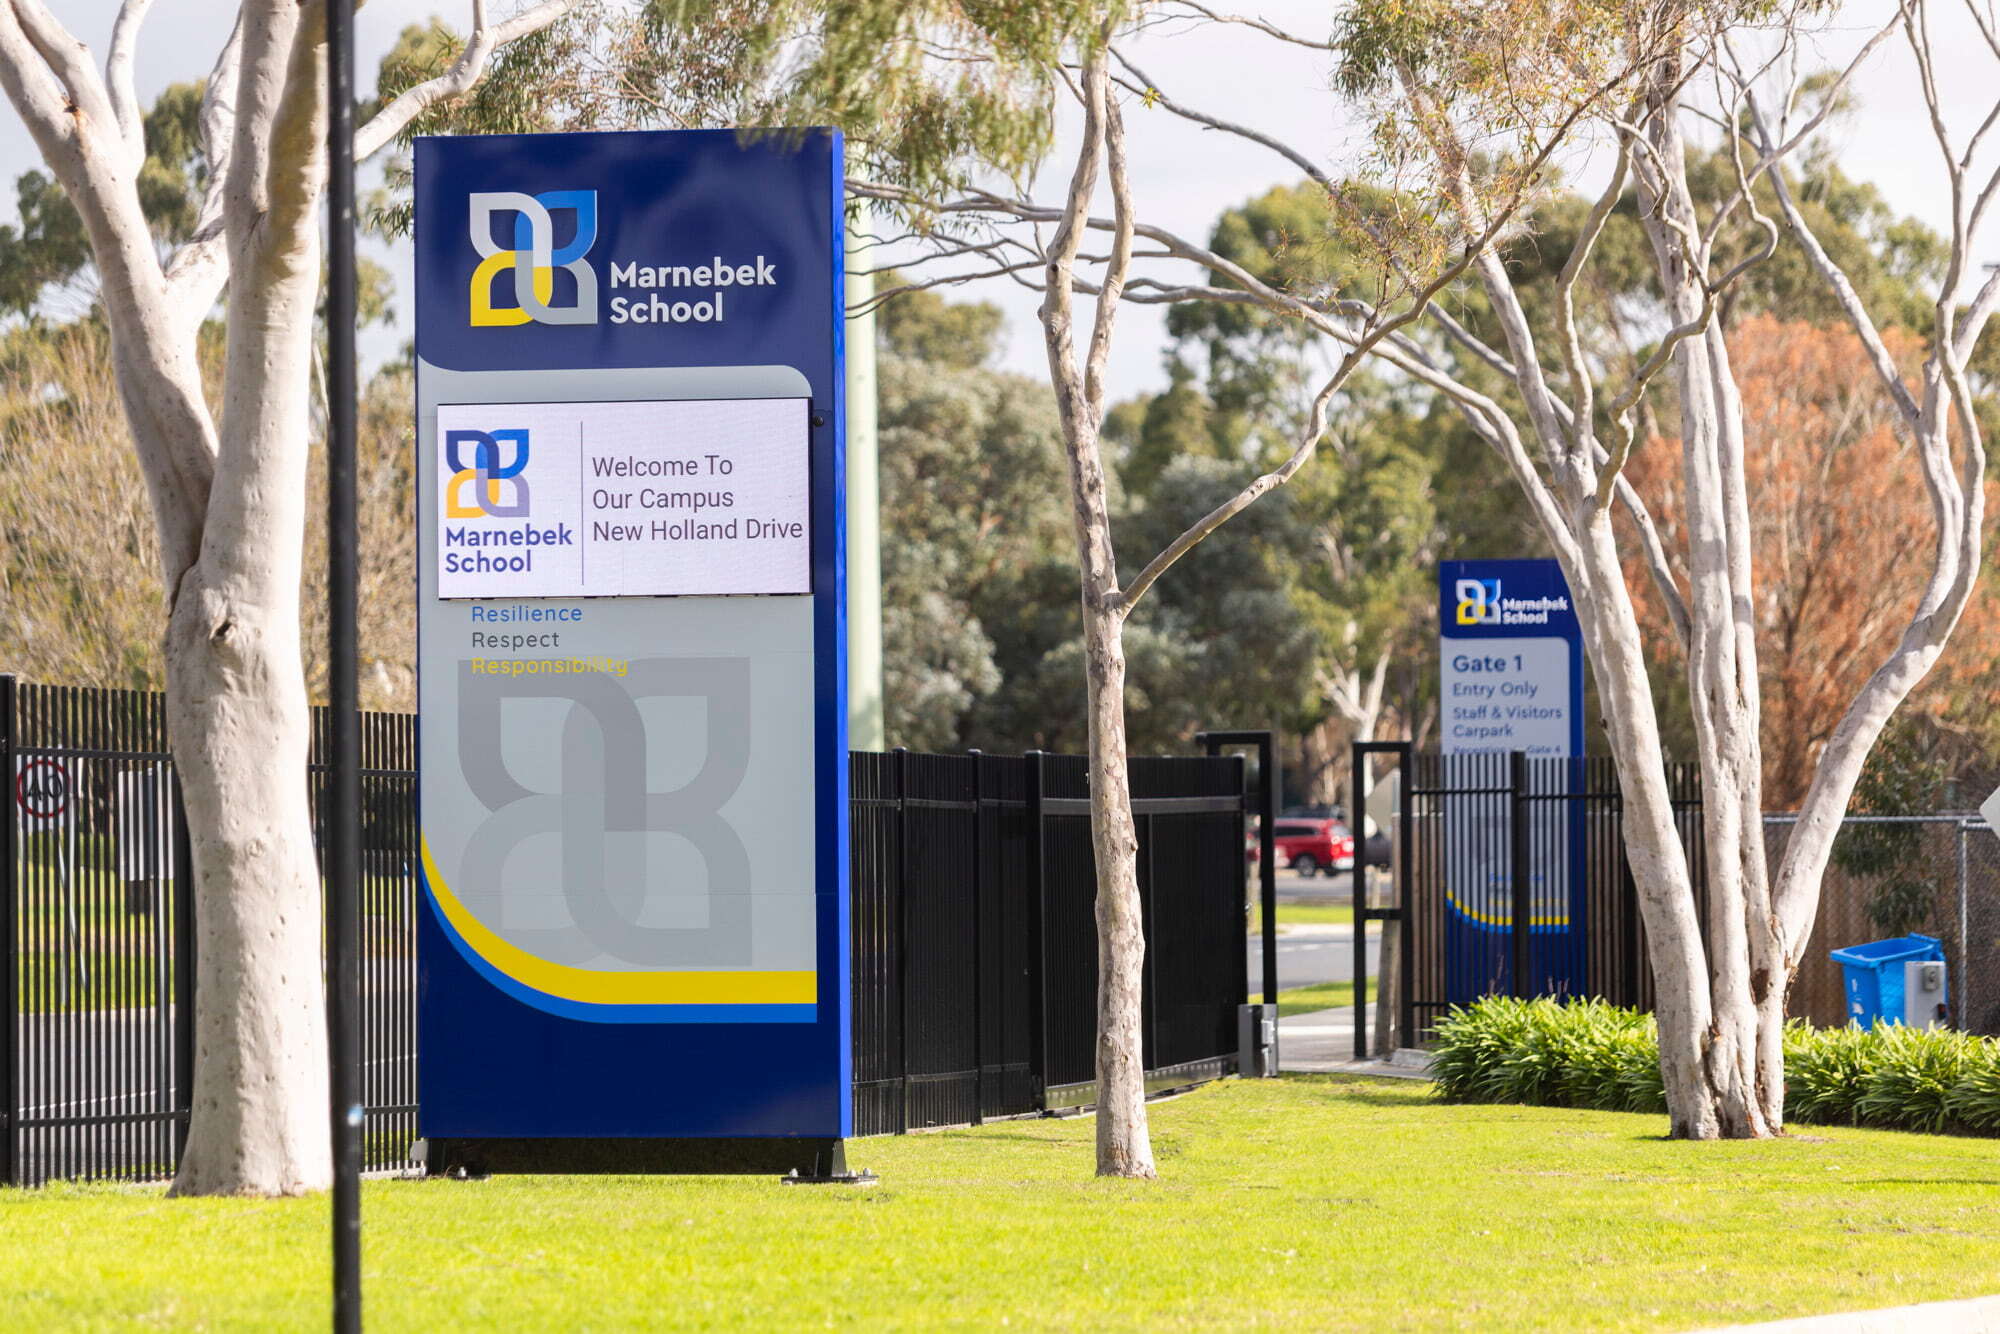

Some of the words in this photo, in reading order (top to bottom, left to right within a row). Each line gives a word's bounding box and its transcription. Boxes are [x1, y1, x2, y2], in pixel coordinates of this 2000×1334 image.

[610, 255, 776, 288] Marnebek
[610, 292, 723, 324] School
[592, 456, 698, 477] Welcome
[705, 454, 733, 475] To
[593, 489, 632, 510] Our
[640, 489, 734, 513] Campus
[446, 522, 573, 546] Marnebek
[593, 521, 643, 541] New
[651, 518, 738, 540] Holland
[746, 518, 803, 539] Drive
[446, 550, 532, 573] School
[1502, 596, 1568, 611] Marnebek
[472, 606, 583, 622] Resilience
[1502, 611, 1548, 624] School
[472, 632, 560, 651] Respect
[471, 656, 629, 677] Responsibility
[1453, 655, 1506, 673] Gate
[1512, 655, 1523, 672] 1
[1453, 682, 1496, 698] Entry
[1501, 681, 1538, 698] Only
[1453, 706, 1487, 719] Staff
[1491, 707, 1502, 719] &
[1506, 706, 1562, 719] Visitors
[1453, 725, 1513, 739] Carpark
